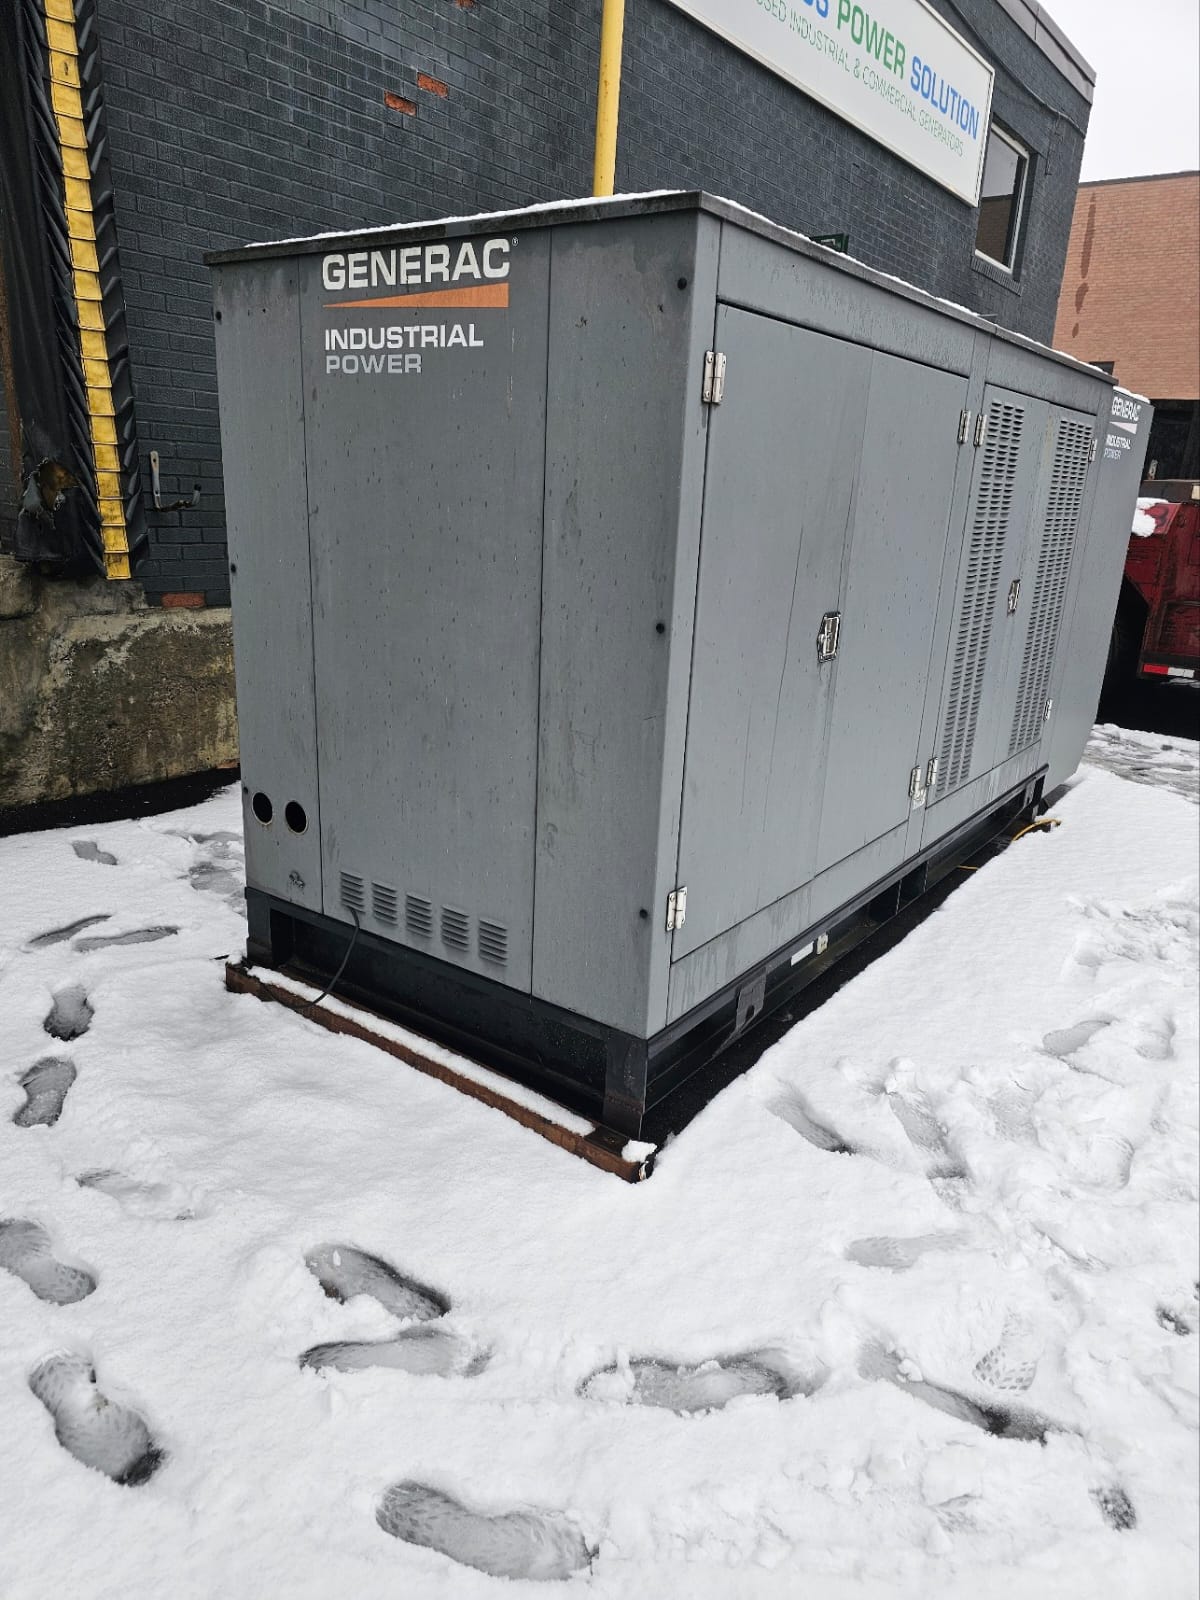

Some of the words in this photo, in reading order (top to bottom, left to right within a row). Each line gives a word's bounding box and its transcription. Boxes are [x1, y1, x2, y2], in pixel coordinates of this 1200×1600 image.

[755, 0, 787, 22] SED
[789, 8, 850, 73] INDUSTRIAL
[853, 58, 860, 78] &
[862, 66, 917, 122] COMMERCIAL
[918, 109, 964, 158] GENERATORS
[837, 0, 907, 80] POWER
[910, 56, 979, 140] SOLUTION
[322, 238, 510, 290] GENERAC
[325, 324, 484, 350] INDUSTRIAL
[326, 353, 423, 374] POWER
